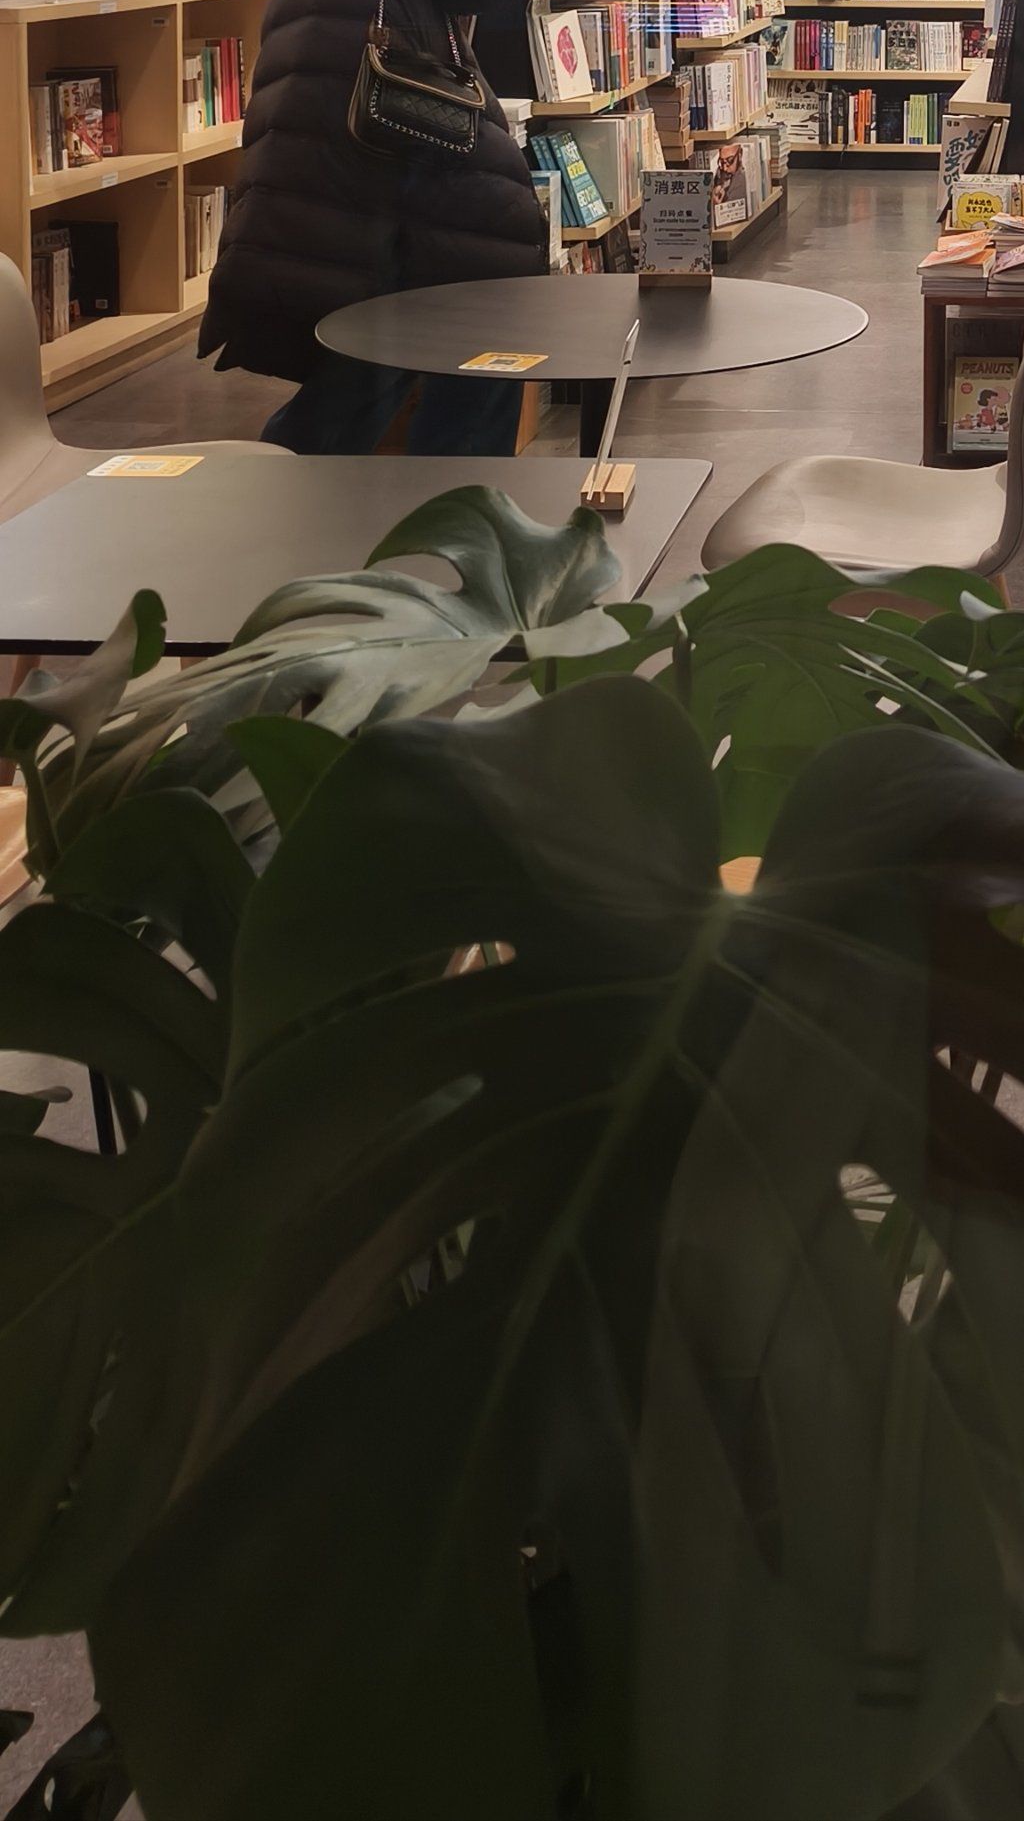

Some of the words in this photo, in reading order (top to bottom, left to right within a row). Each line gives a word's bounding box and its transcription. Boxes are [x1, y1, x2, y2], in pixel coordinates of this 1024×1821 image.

[655, 180, 700, 195] 消费区
[960, 362, 1014, 375] PEANUTS
